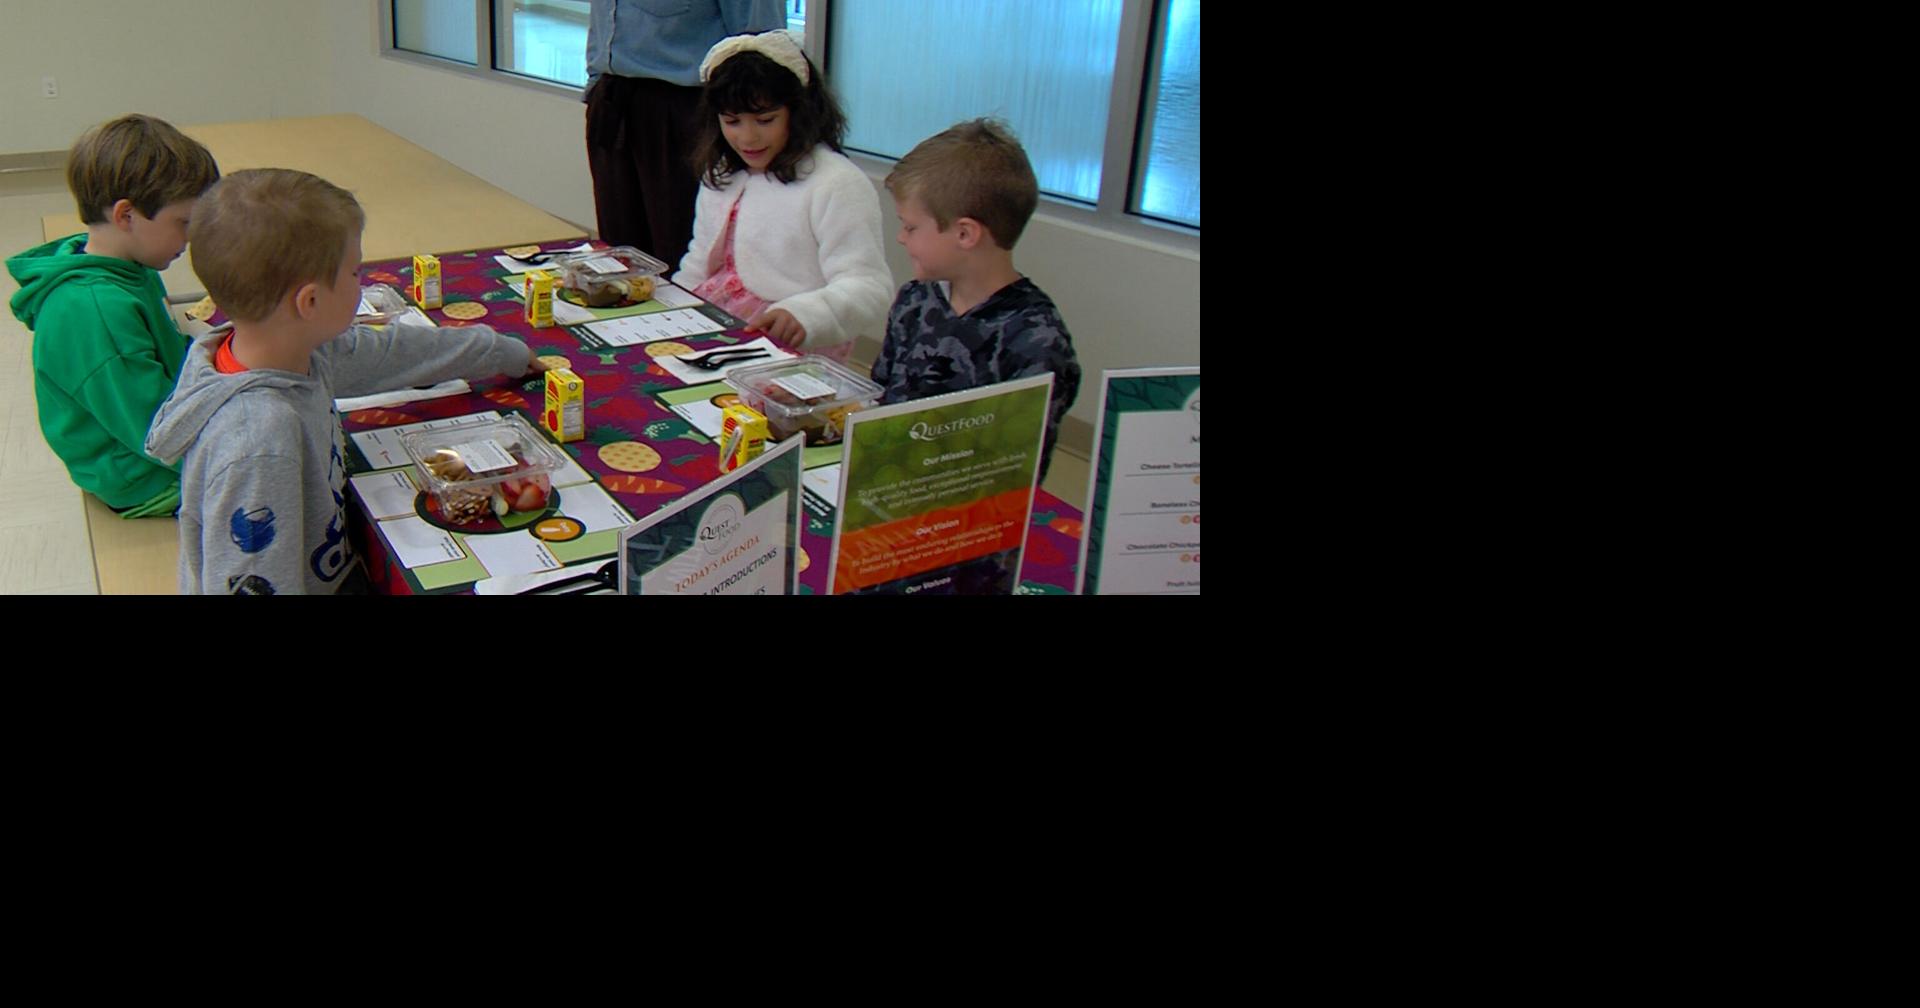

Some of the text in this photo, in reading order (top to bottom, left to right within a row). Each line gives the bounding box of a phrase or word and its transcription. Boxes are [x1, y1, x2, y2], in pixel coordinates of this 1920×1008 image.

[922, 450, 974, 466] Our Mission
[1140, 463, 1171, 471] Cheese
[868, 483, 897, 497] provide
[899, 479, 911, 488] the
[916, 519, 960, 537] Our Vision
[719, 535, 760, 566] AGENDA
[862, 553, 881, 565] build
[882, 551, 895, 560] the
[896, 546, 914, 556] most
[915, 538, 948, 552] enduring
[901, 552, 921, 564] what
[922, 550, 933, 558] we
[710, 547, 777, 596] INTRODUCTIONS
[905, 584, 922, 595] Our
